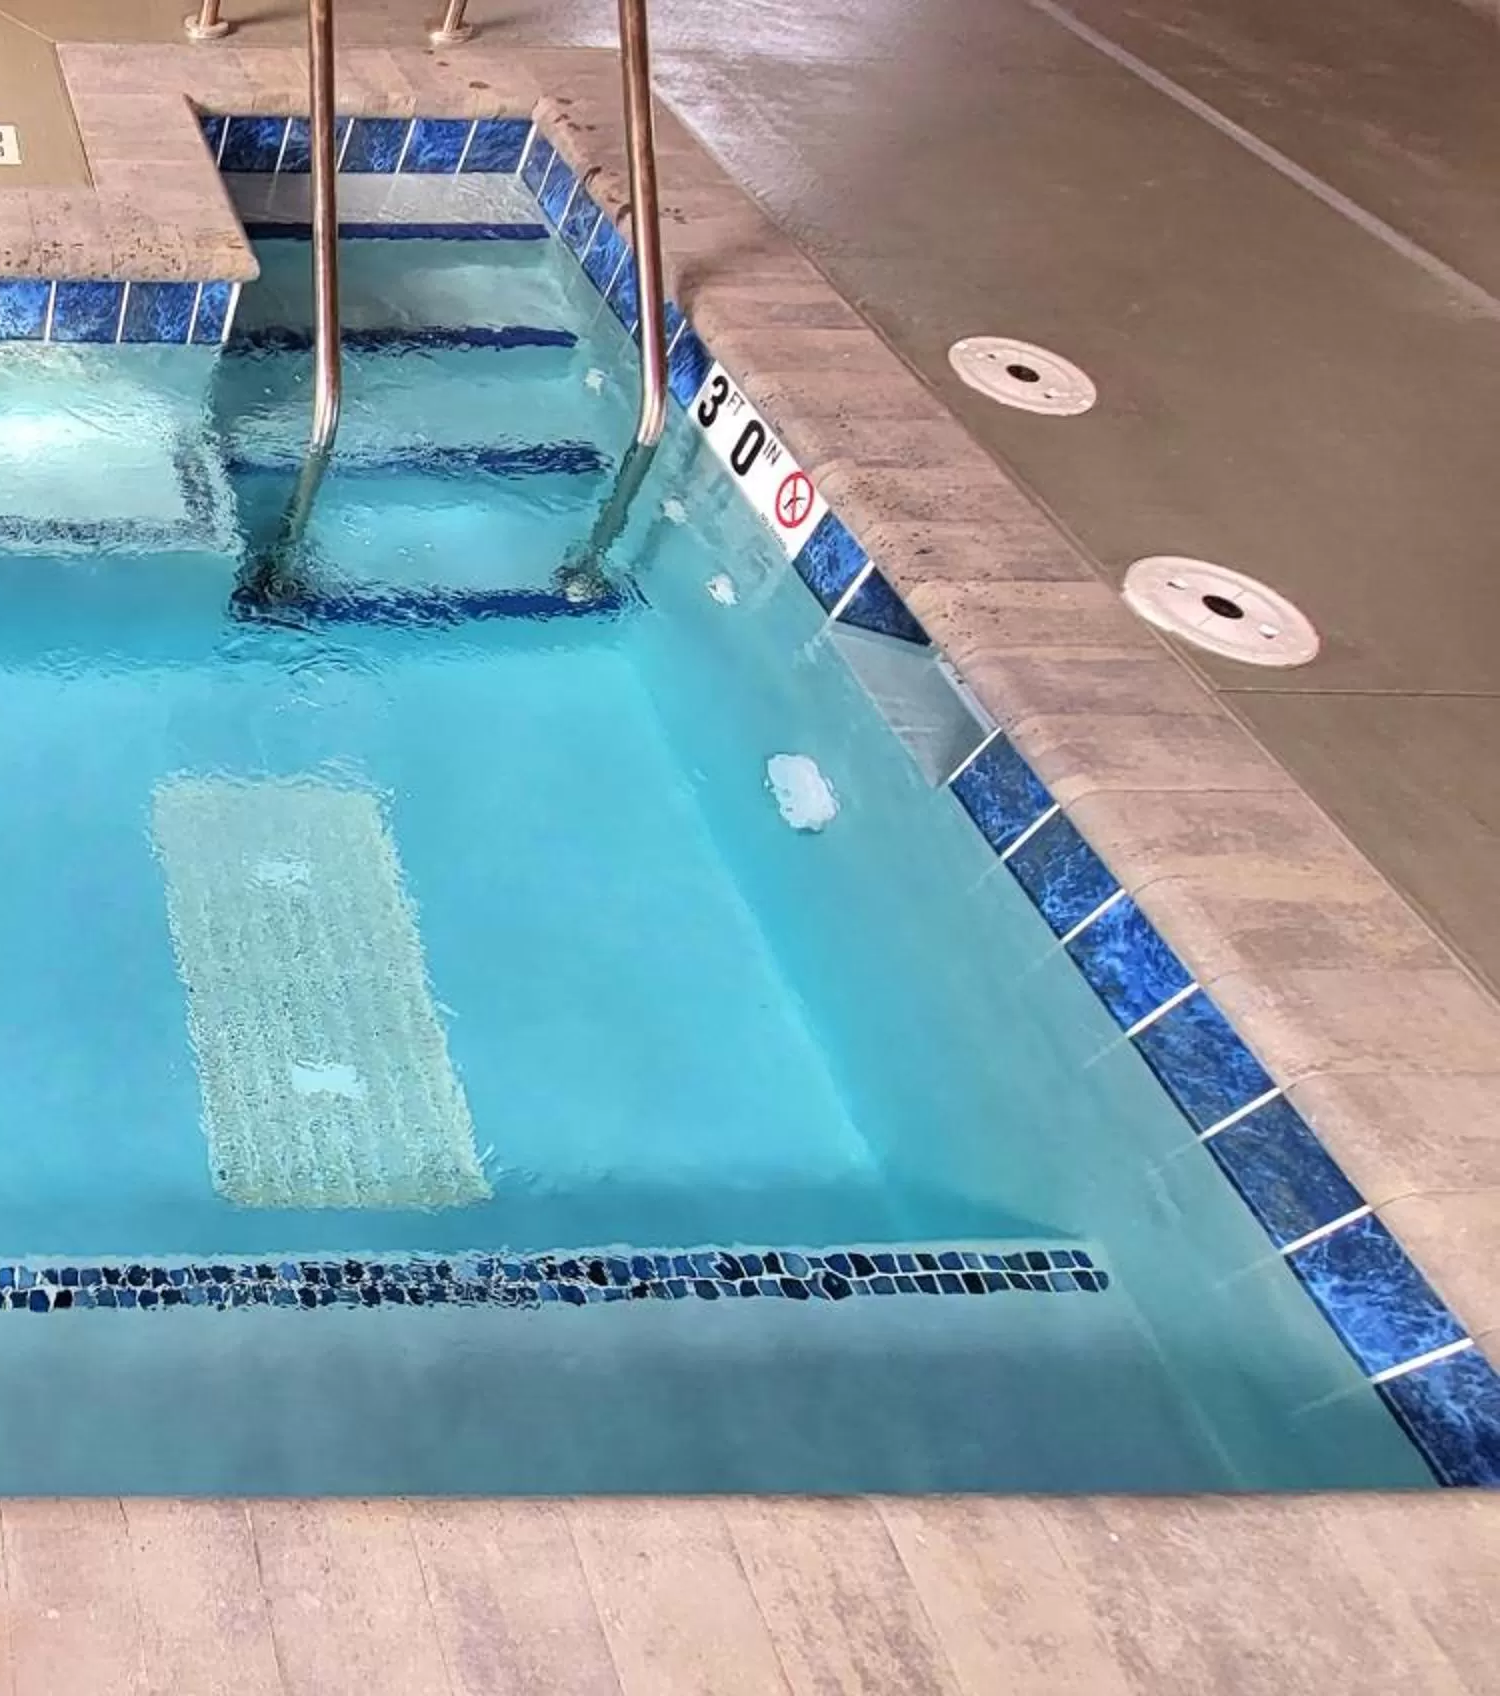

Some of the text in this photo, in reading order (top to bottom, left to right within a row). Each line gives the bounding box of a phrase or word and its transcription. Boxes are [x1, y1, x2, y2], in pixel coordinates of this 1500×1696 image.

[697, 375, 782, 476] 3 FT 0 IN
